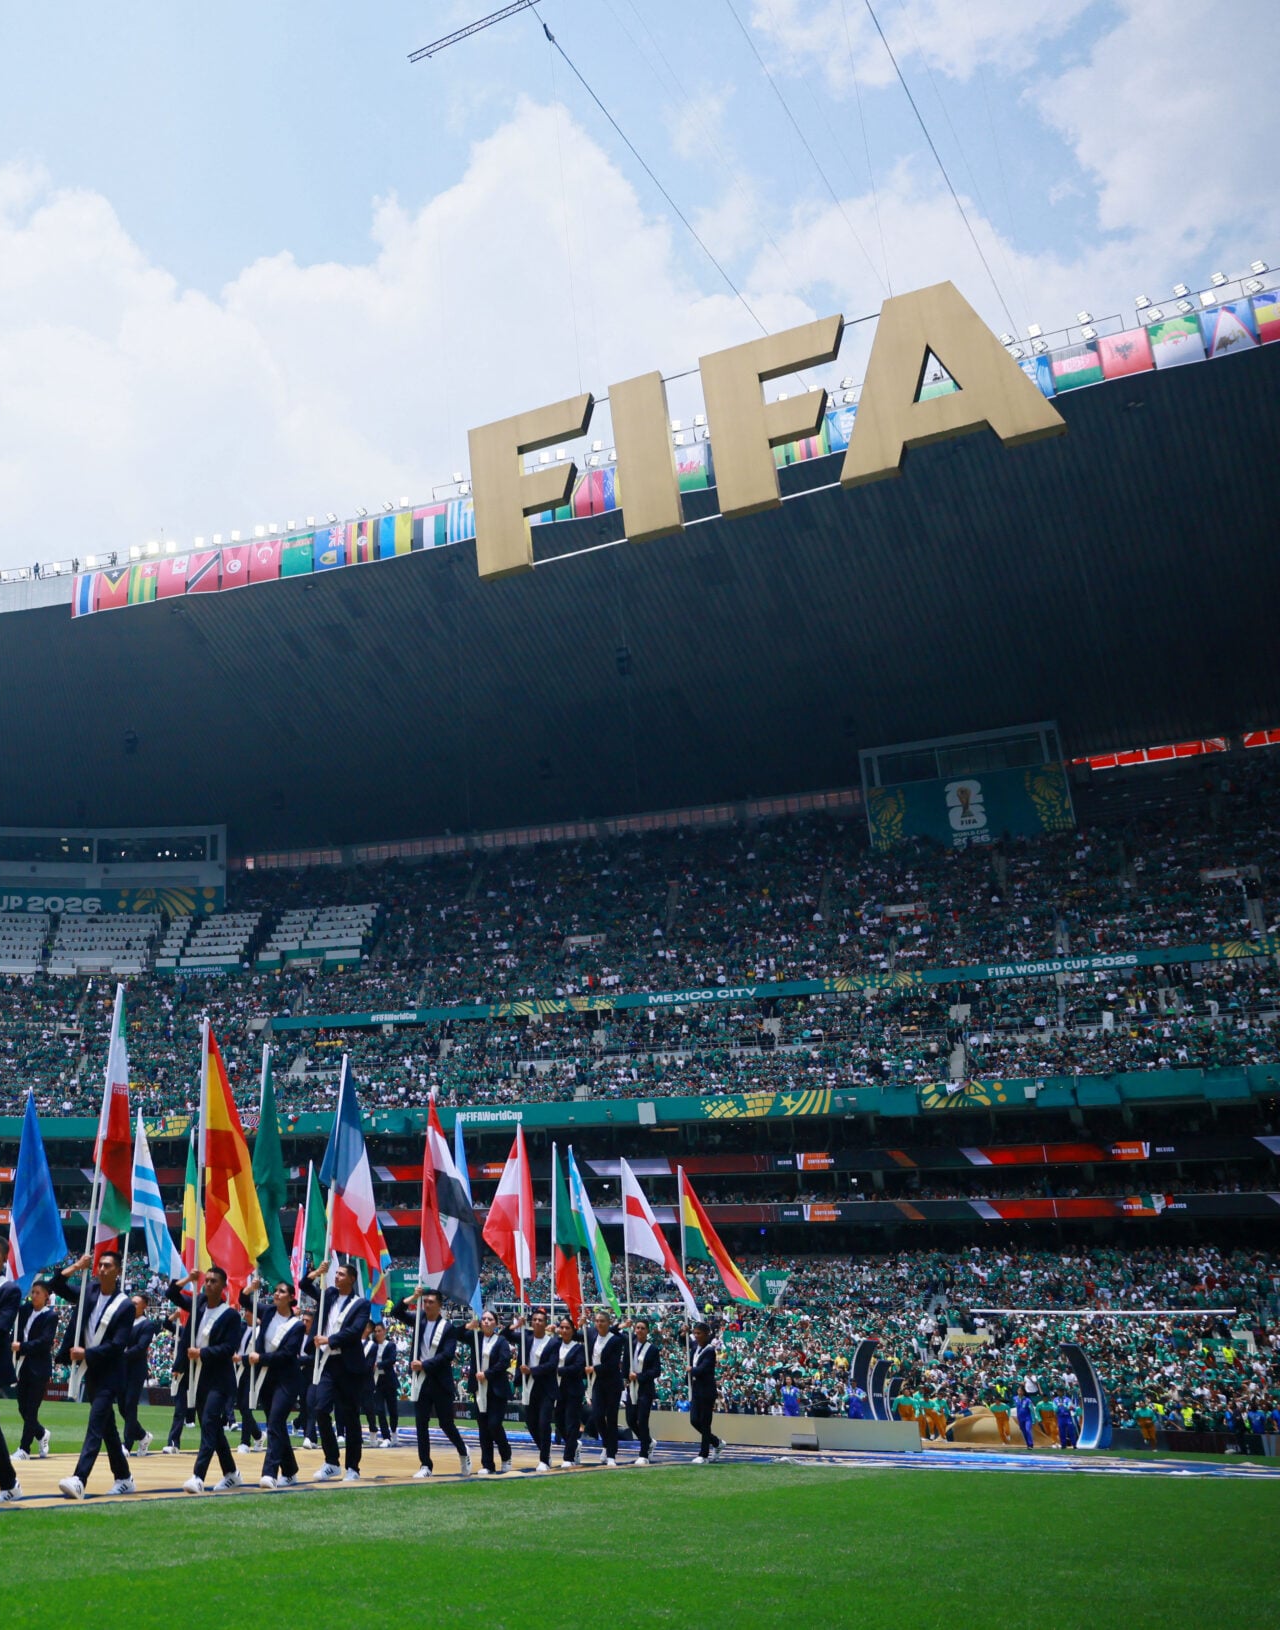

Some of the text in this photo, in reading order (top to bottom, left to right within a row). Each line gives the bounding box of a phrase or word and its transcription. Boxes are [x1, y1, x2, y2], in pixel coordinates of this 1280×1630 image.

[467, 280, 1067, 582] FIFA
[26, 896, 102, 913] 2026
[988, 955, 1138, 977] FIFA WORLD CUP 2026
[648, 988, 756, 1003] MEXICO CITY
[371, 1012, 417, 1022] #FIFAWorldCup
[460, 1110, 522, 1122] #FIFAWorldCup
